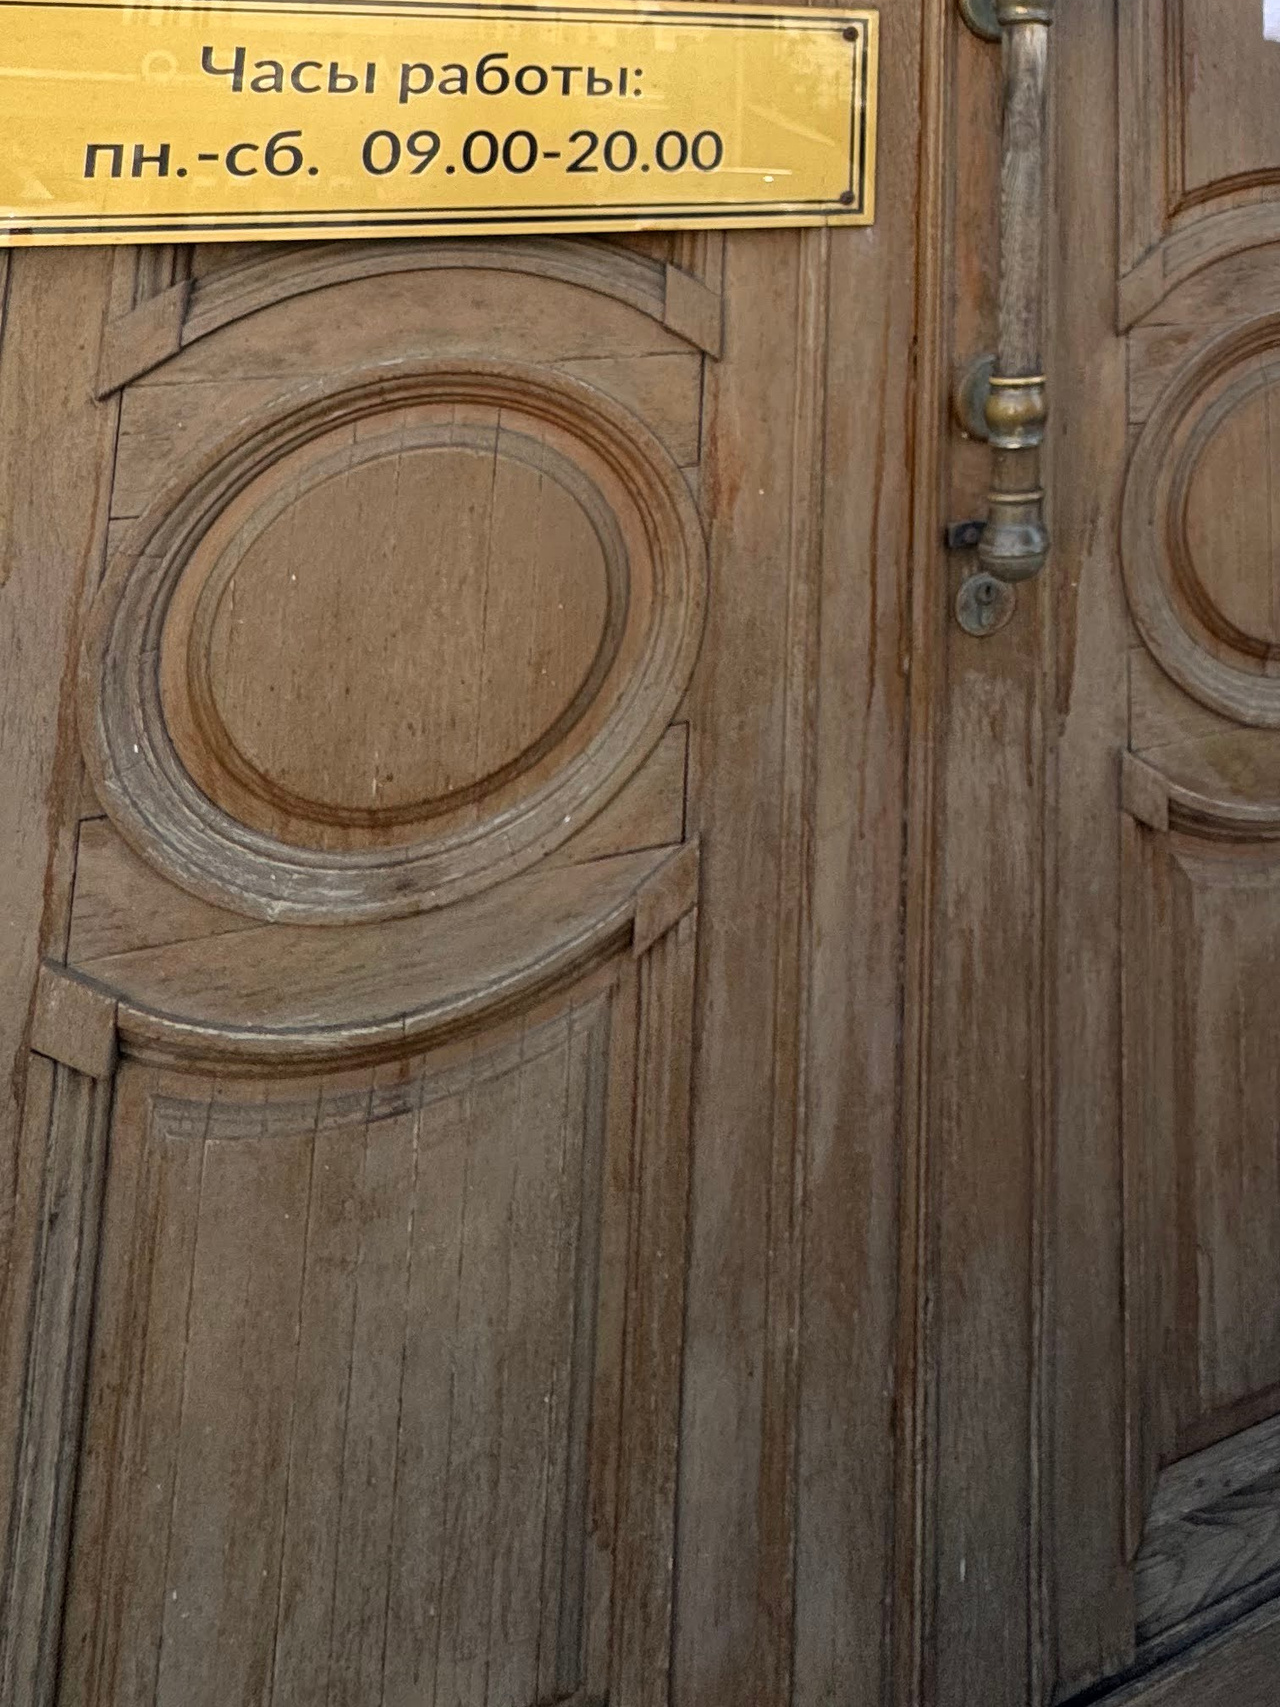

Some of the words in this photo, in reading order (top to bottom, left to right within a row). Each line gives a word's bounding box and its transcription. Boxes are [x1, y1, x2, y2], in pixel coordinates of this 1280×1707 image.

[201, 45, 375, 96] Часы
[398, 53, 645, 104] работы:
[83, 130, 320, 180] пн.-сб.
[361, 129, 724, 175] 09.00-20.00
